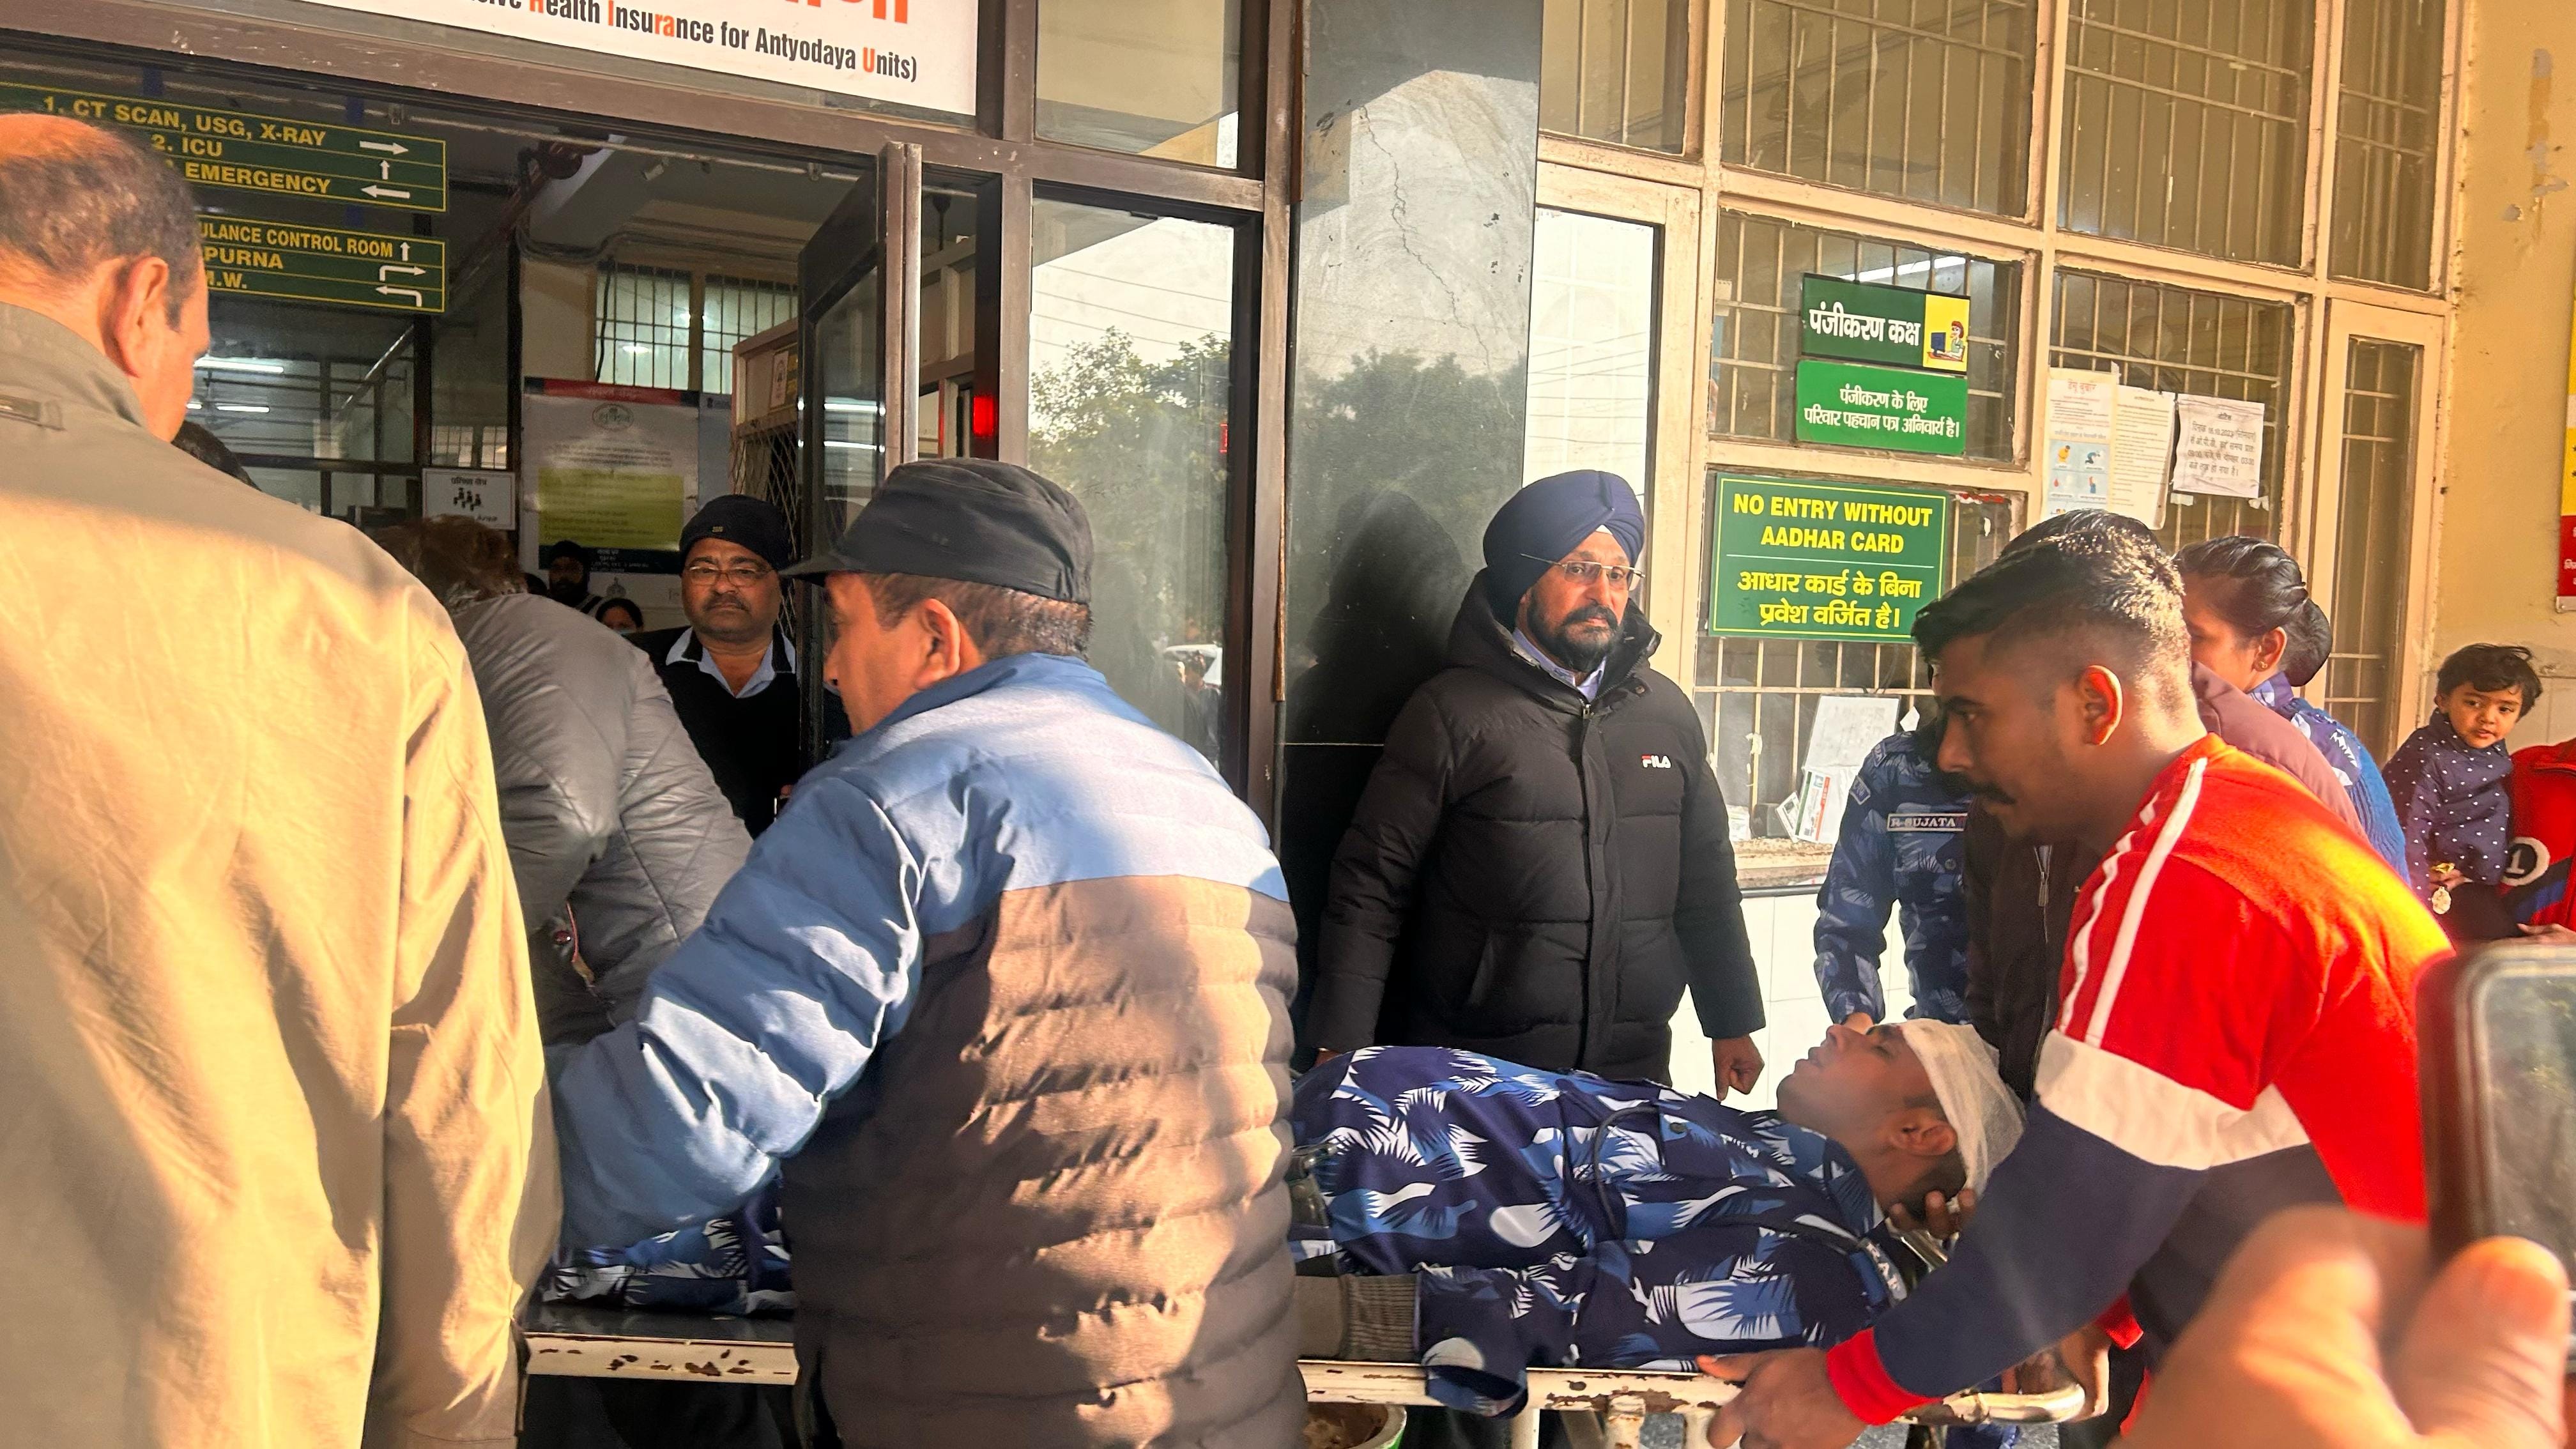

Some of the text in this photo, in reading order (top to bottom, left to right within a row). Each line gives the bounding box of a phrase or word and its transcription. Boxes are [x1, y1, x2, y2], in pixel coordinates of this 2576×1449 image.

[608, 0, 714, 44] Insurance
[721, 21, 749, 50] for
[755, 27, 856, 70] Antyodaya
[862, 47, 917, 83] Units)
[73, 99, 106, 118] CT
[114, 104, 187, 133] SCAN,
[195, 114, 252, 141] USG,
[260, 122, 326, 146] X-RAY
[151, 134, 222, 157] 2. ICU
[185, 162, 331, 194] EMERGENCY
[199, 222, 394, 258] ULANCE CONTROL ROOM
[203, 246, 283, 269] PURNA
[1809, 301, 1921, 346] पंजीकरण कक्ष
[1839, 383, 1928, 413] पंजीकरण के लिए
[1804, 403, 1842, 426] परिवार
[1843, 411, 1880, 430] पहचान
[1883, 415, 1900, 432] पत्र
[1901, 413, 1944, 436] अनिवार्य
[1733, 493, 1933, 527] NO ENTRY WITHOUT
[1760, 526, 1905, 553] AADHAR CARD
[1737, 569, 1922, 599] आधार कार्ड के बिना
[1759, 597, 1809, 626] प्रवेश
[1813, 599, 1872, 627] वर्जित
[1642, 755, 1671, 769] FILA
